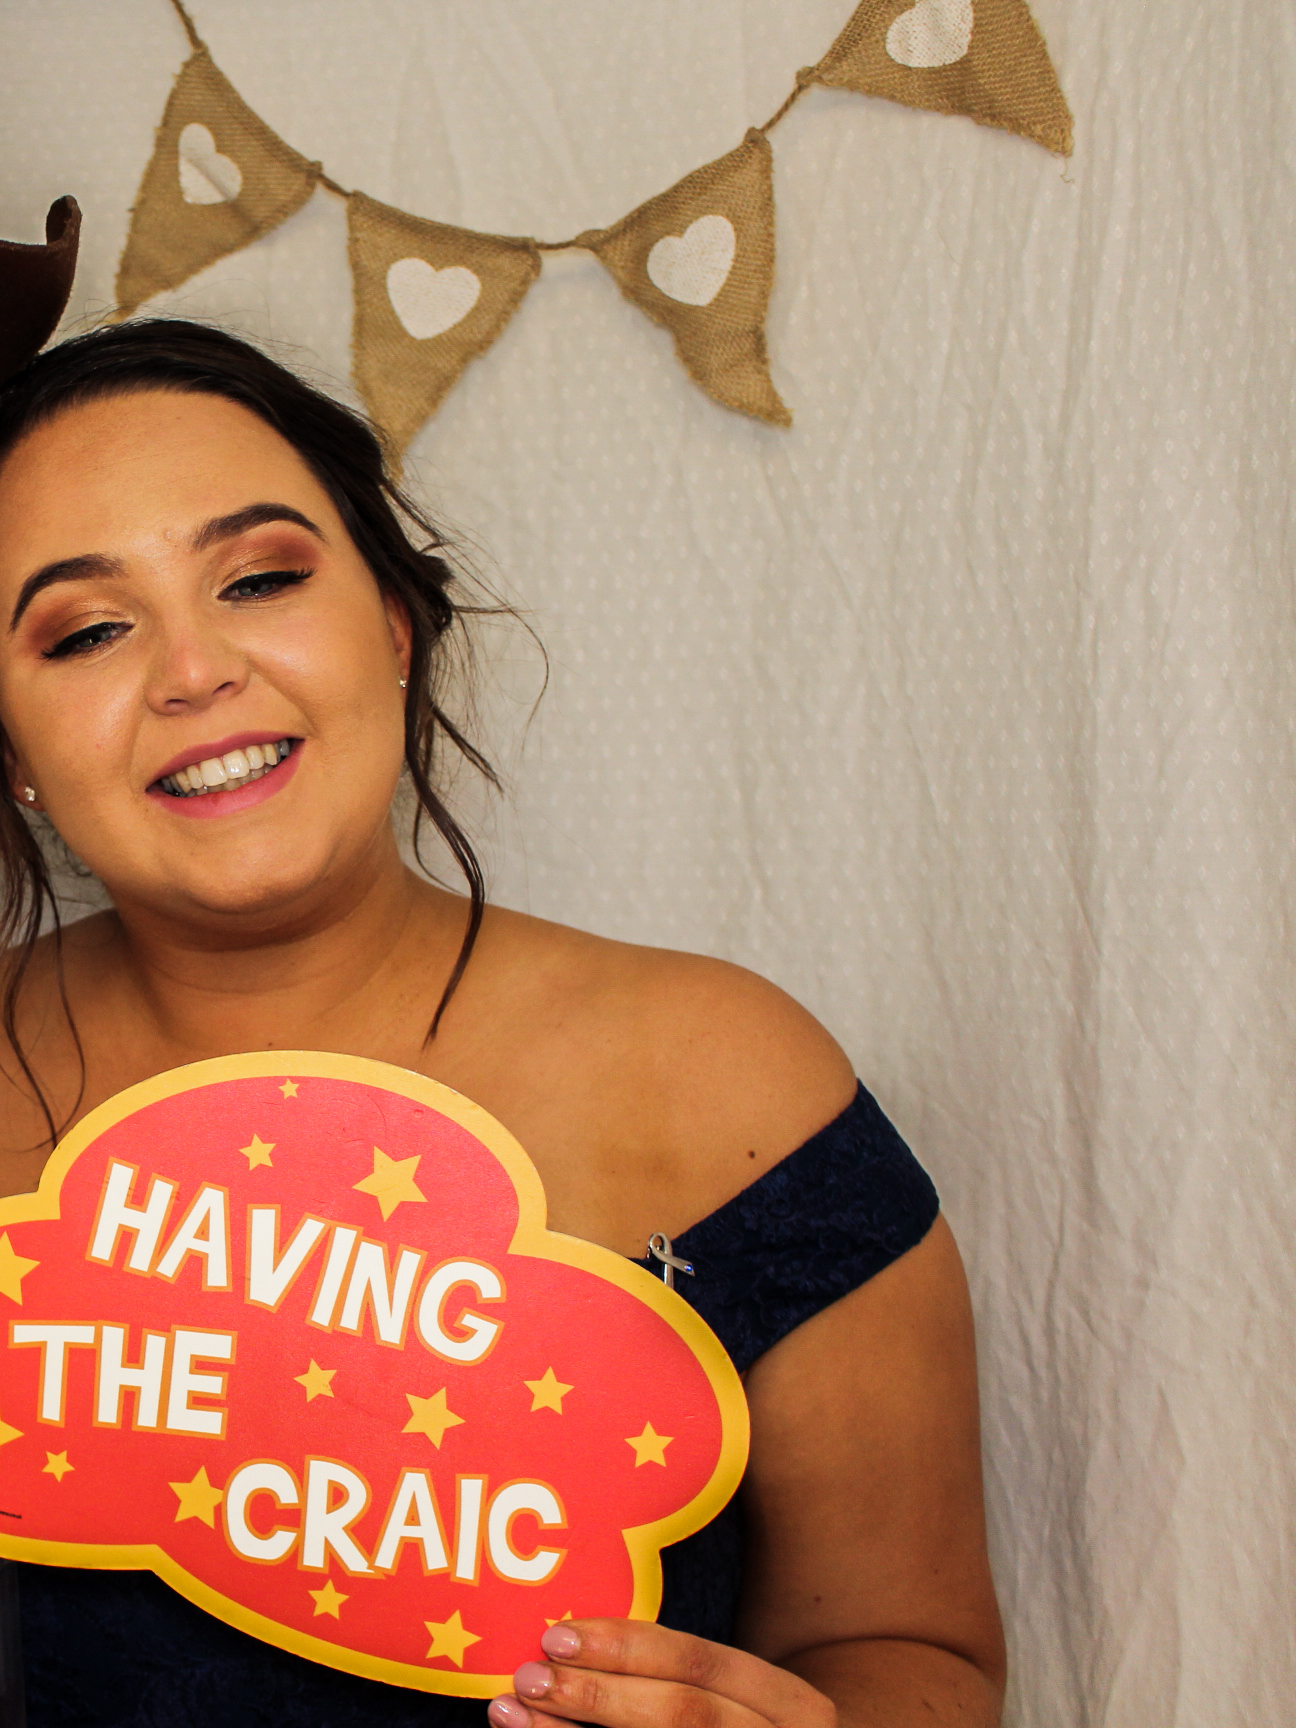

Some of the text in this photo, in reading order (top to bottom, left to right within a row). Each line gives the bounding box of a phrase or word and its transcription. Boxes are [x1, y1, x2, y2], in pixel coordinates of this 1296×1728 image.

[88, 1160, 504, 1364] HAVING
[10, 1322, 235, 1437] THE
[225, 1457, 566, 1583] CRAIC
